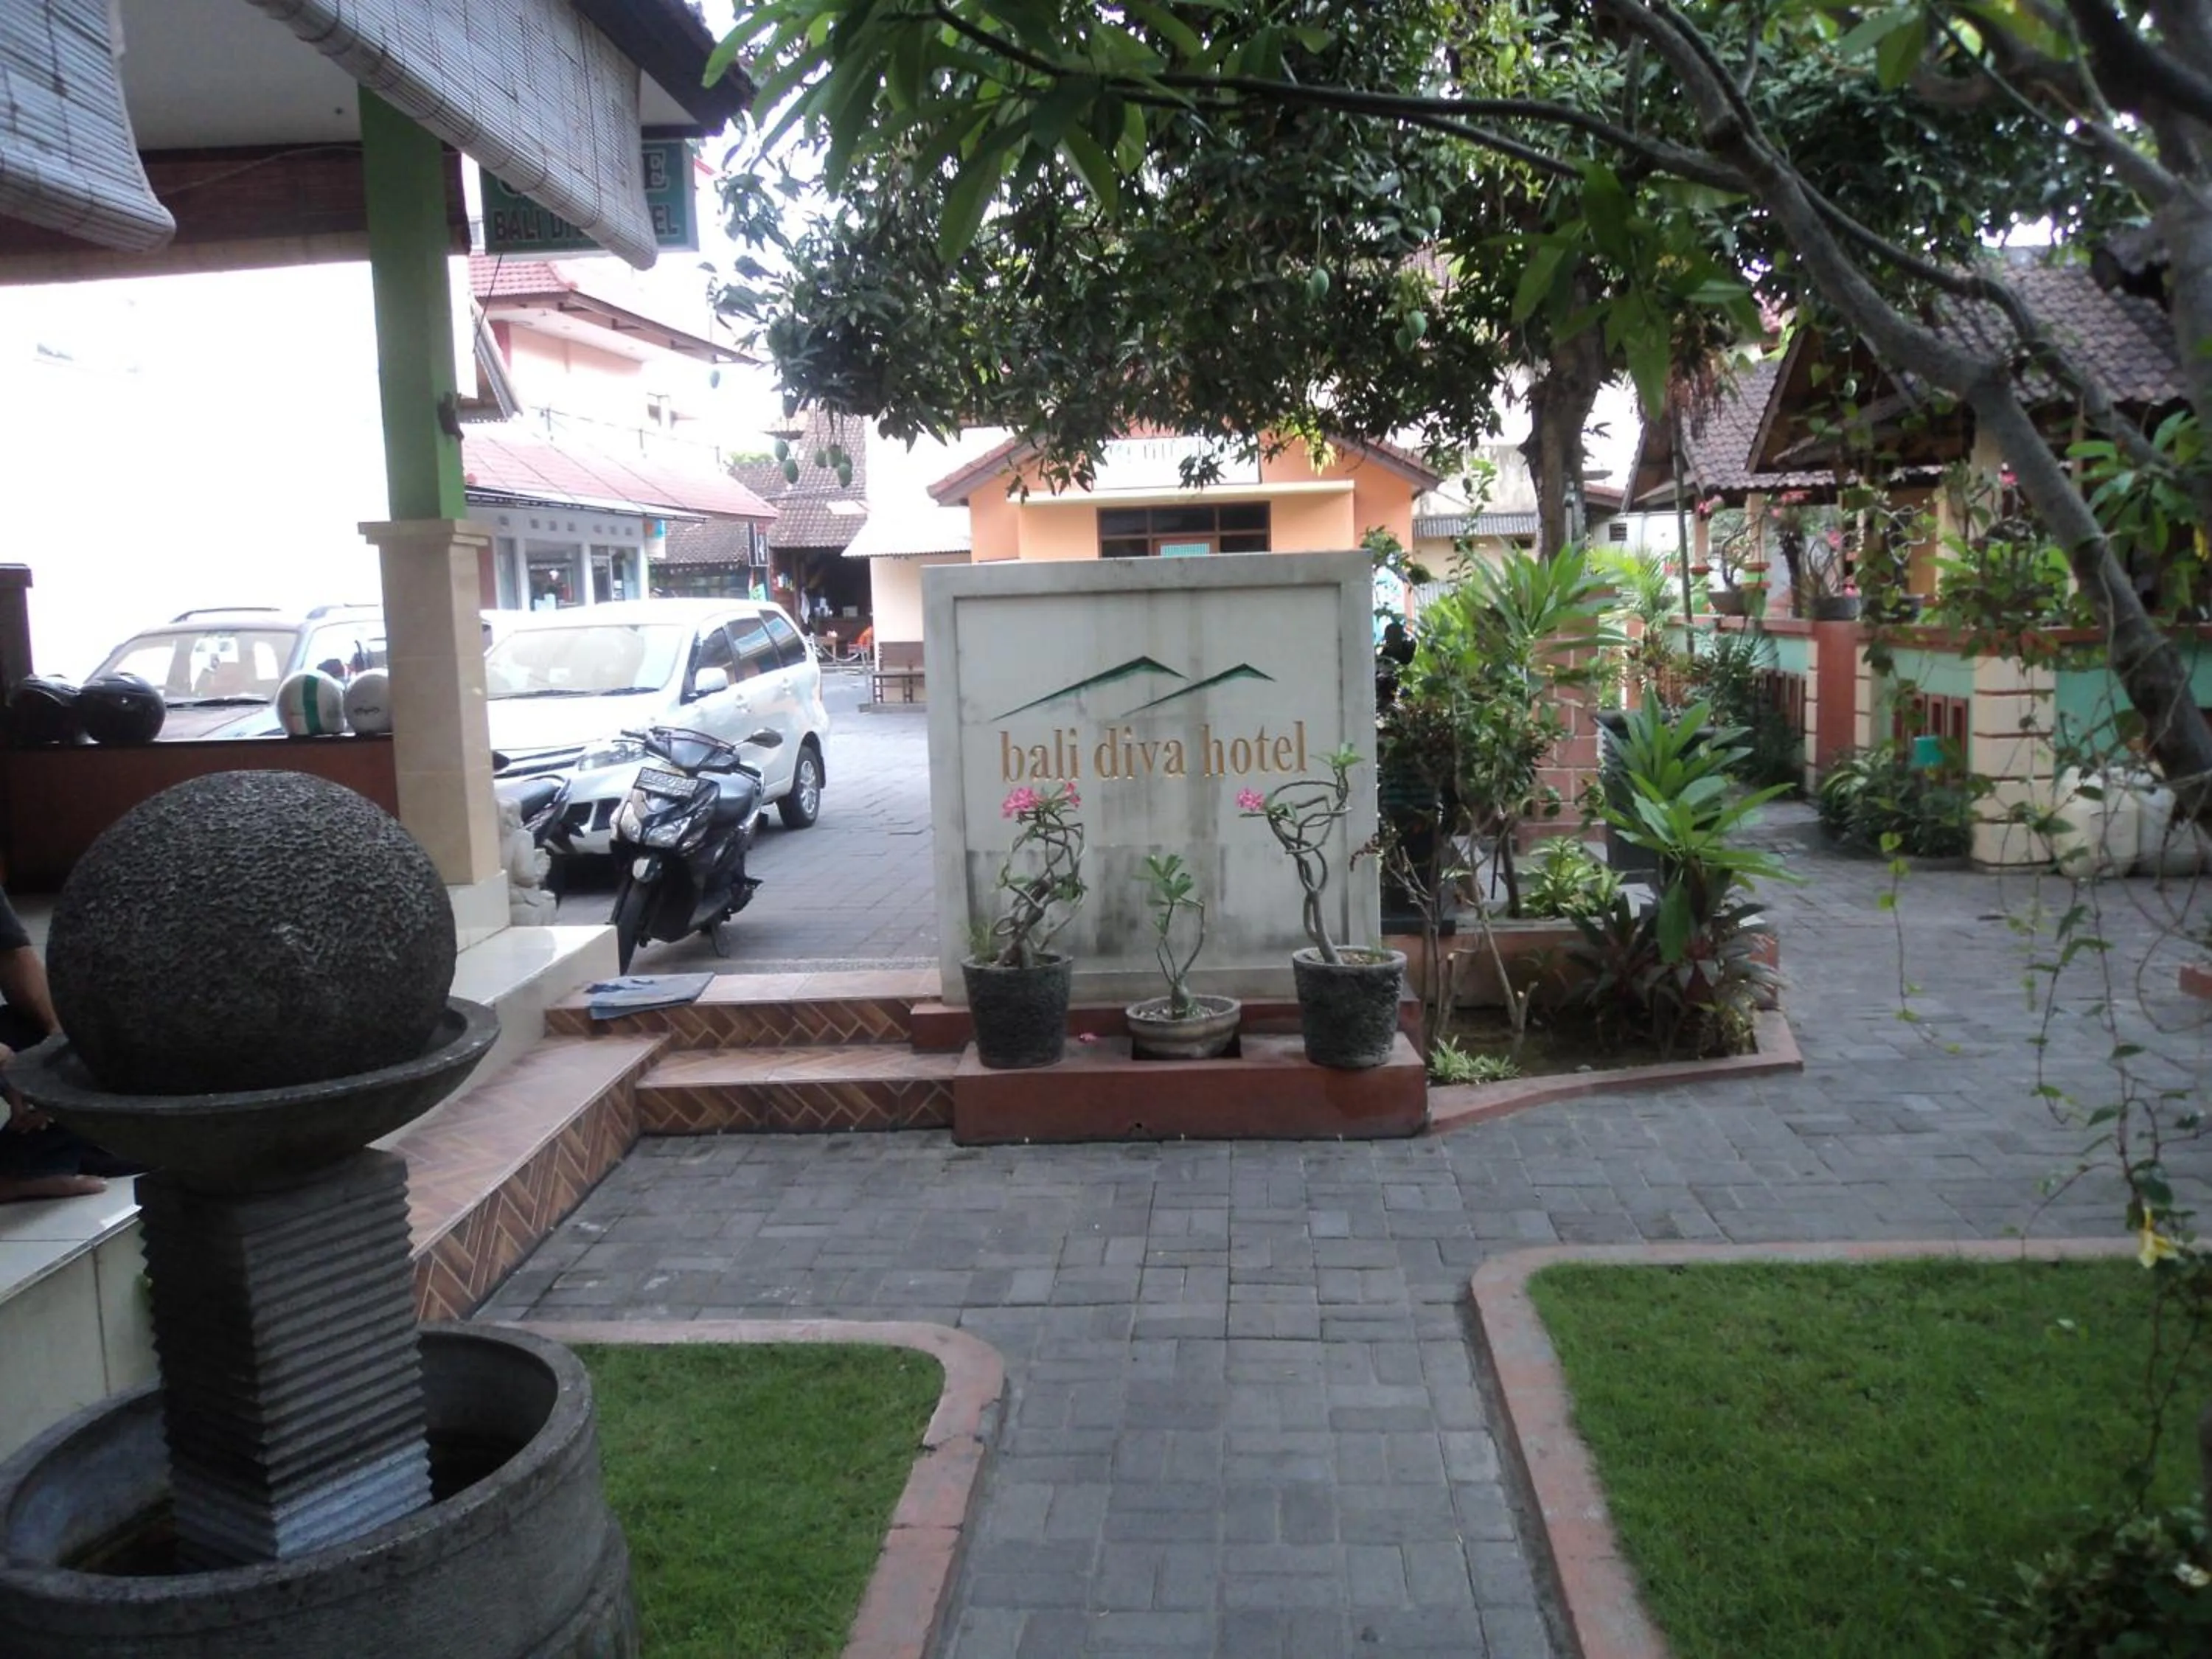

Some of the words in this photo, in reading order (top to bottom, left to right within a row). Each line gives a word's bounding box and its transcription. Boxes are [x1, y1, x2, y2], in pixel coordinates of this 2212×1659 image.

[493, 209, 543, 241] BALI
[999, 728, 1079, 782] bali
[1093, 726, 1185, 779] diva
[1200, 720, 1309, 778] hotel
